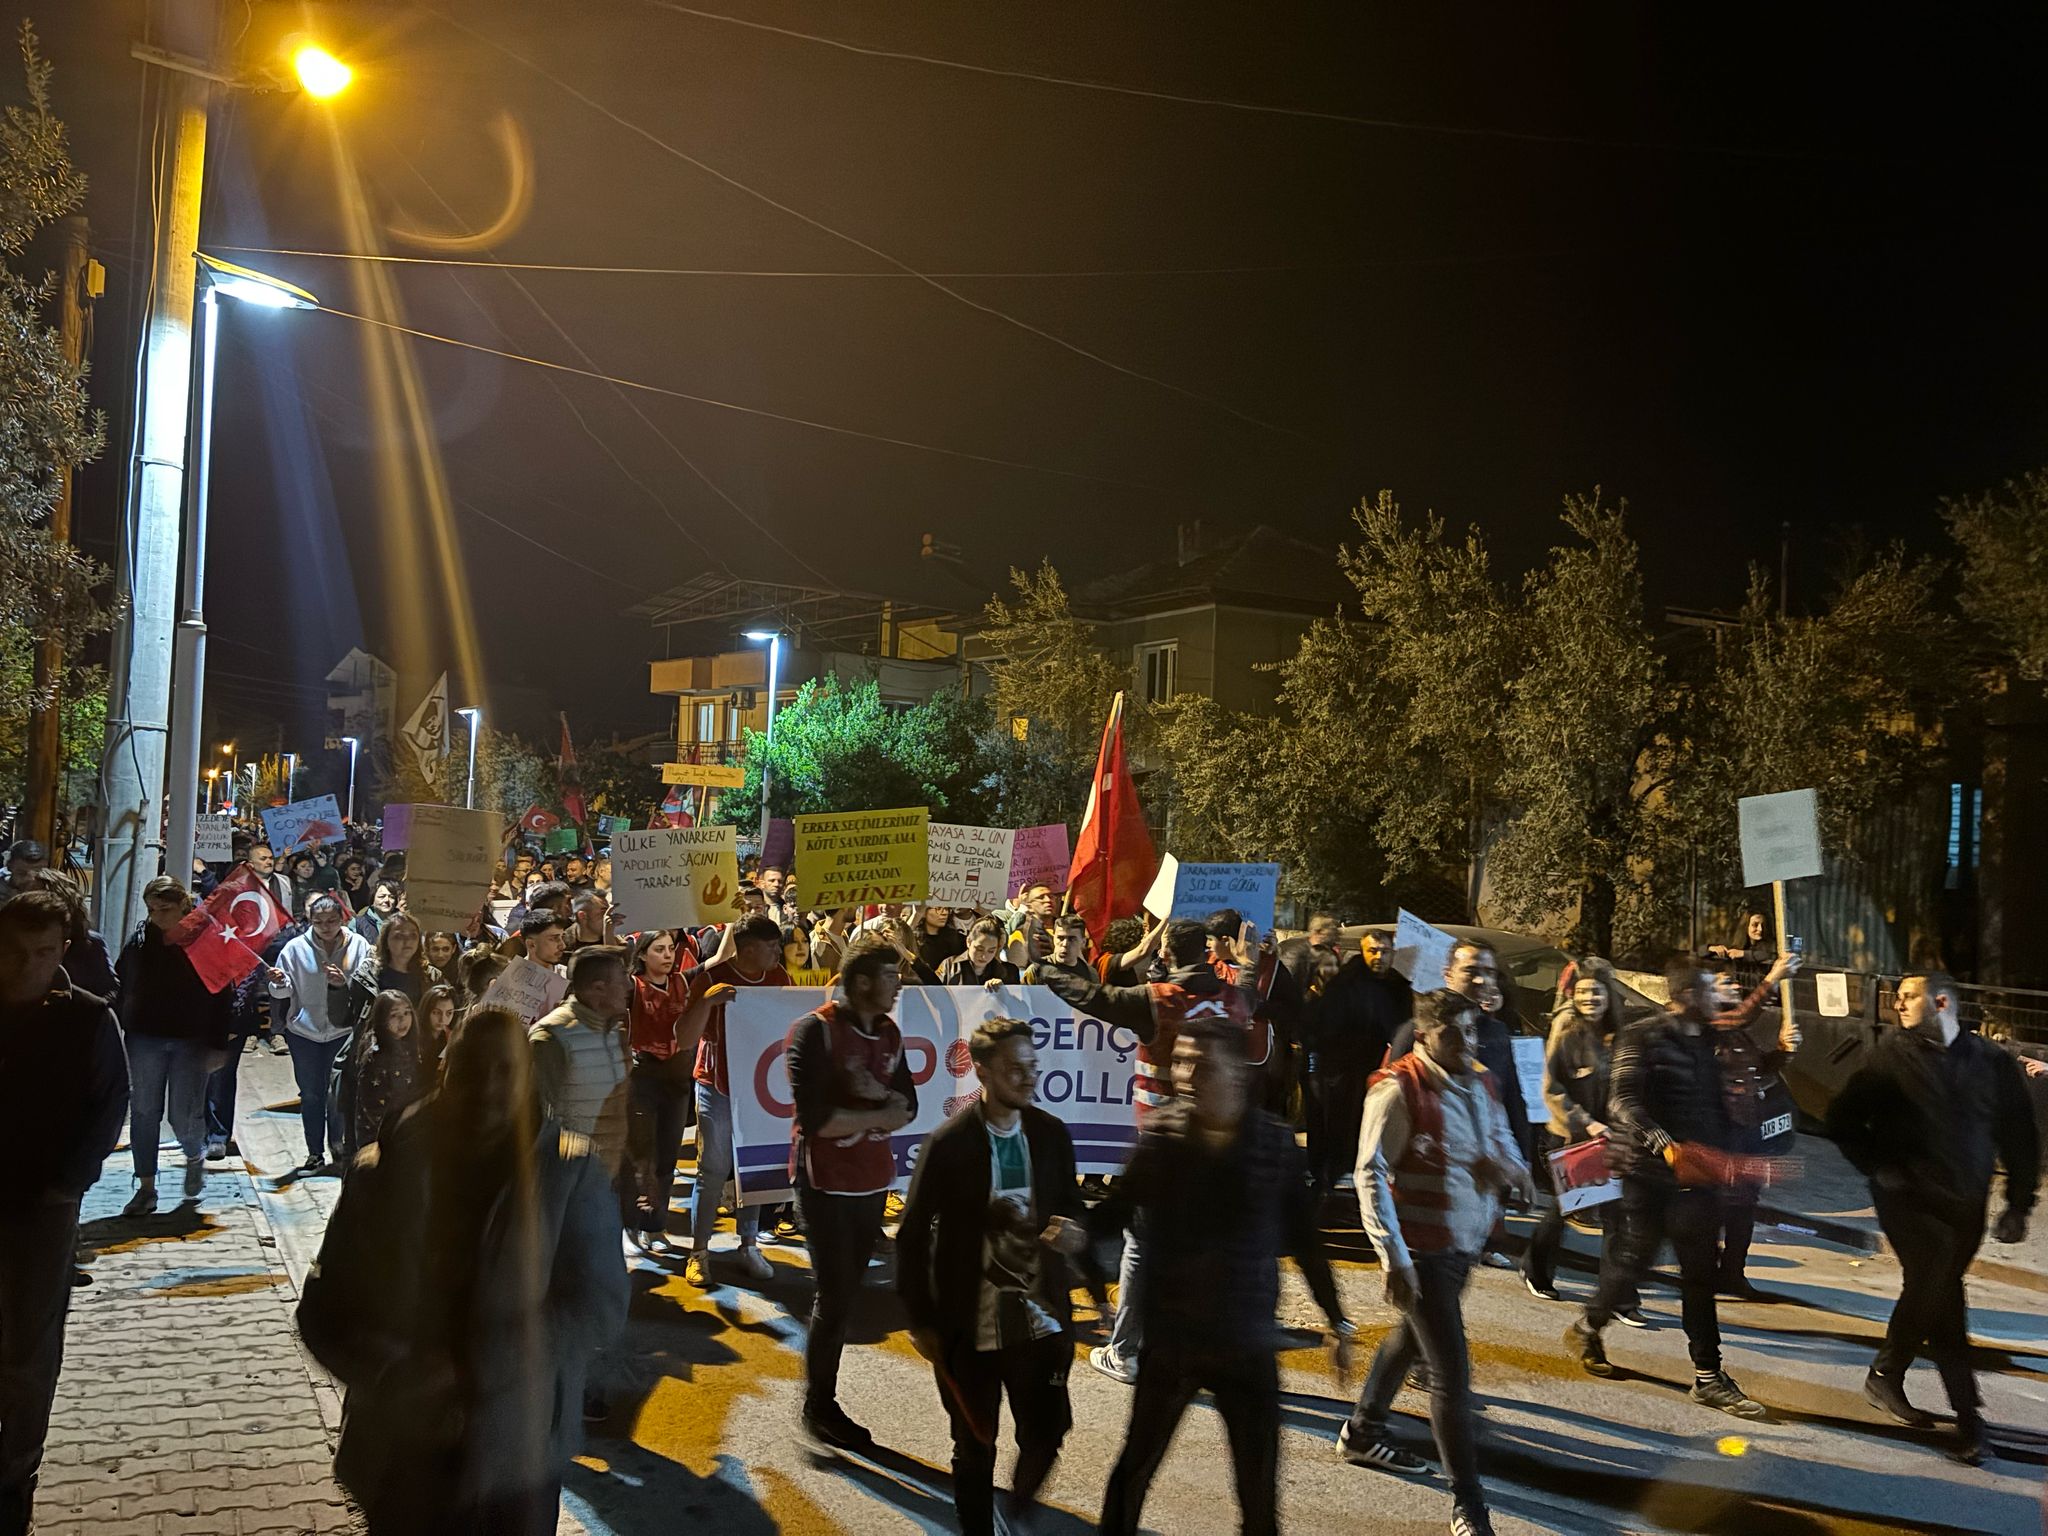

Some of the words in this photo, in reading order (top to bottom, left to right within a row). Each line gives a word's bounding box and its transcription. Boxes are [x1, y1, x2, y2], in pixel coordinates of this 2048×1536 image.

[801, 821, 839, 834] ERKEK
[841, 814, 921, 832] SEÇİMLERİMİZ
[619, 834, 657, 853] ÜLKE
[666, 830, 726, 846] YANARKEN
[806, 835, 836, 851] KÖTÜ
[839, 834, 891, 849] SANIRDIK
[893, 832, 917, 844] AMA
[956, 843, 1001, 859] OLDUĞU
[836, 854, 852, 866] BU
[854, 851, 889, 865] YARIŞI
[822, 871, 844, 884] SEN
[846, 867, 902, 882] KAZANDIN
[1209, 879, 1222, 891] DE
[815, 883, 917, 905] EMİNE!
[1029, 1017, 1139, 1063] GENÇ
